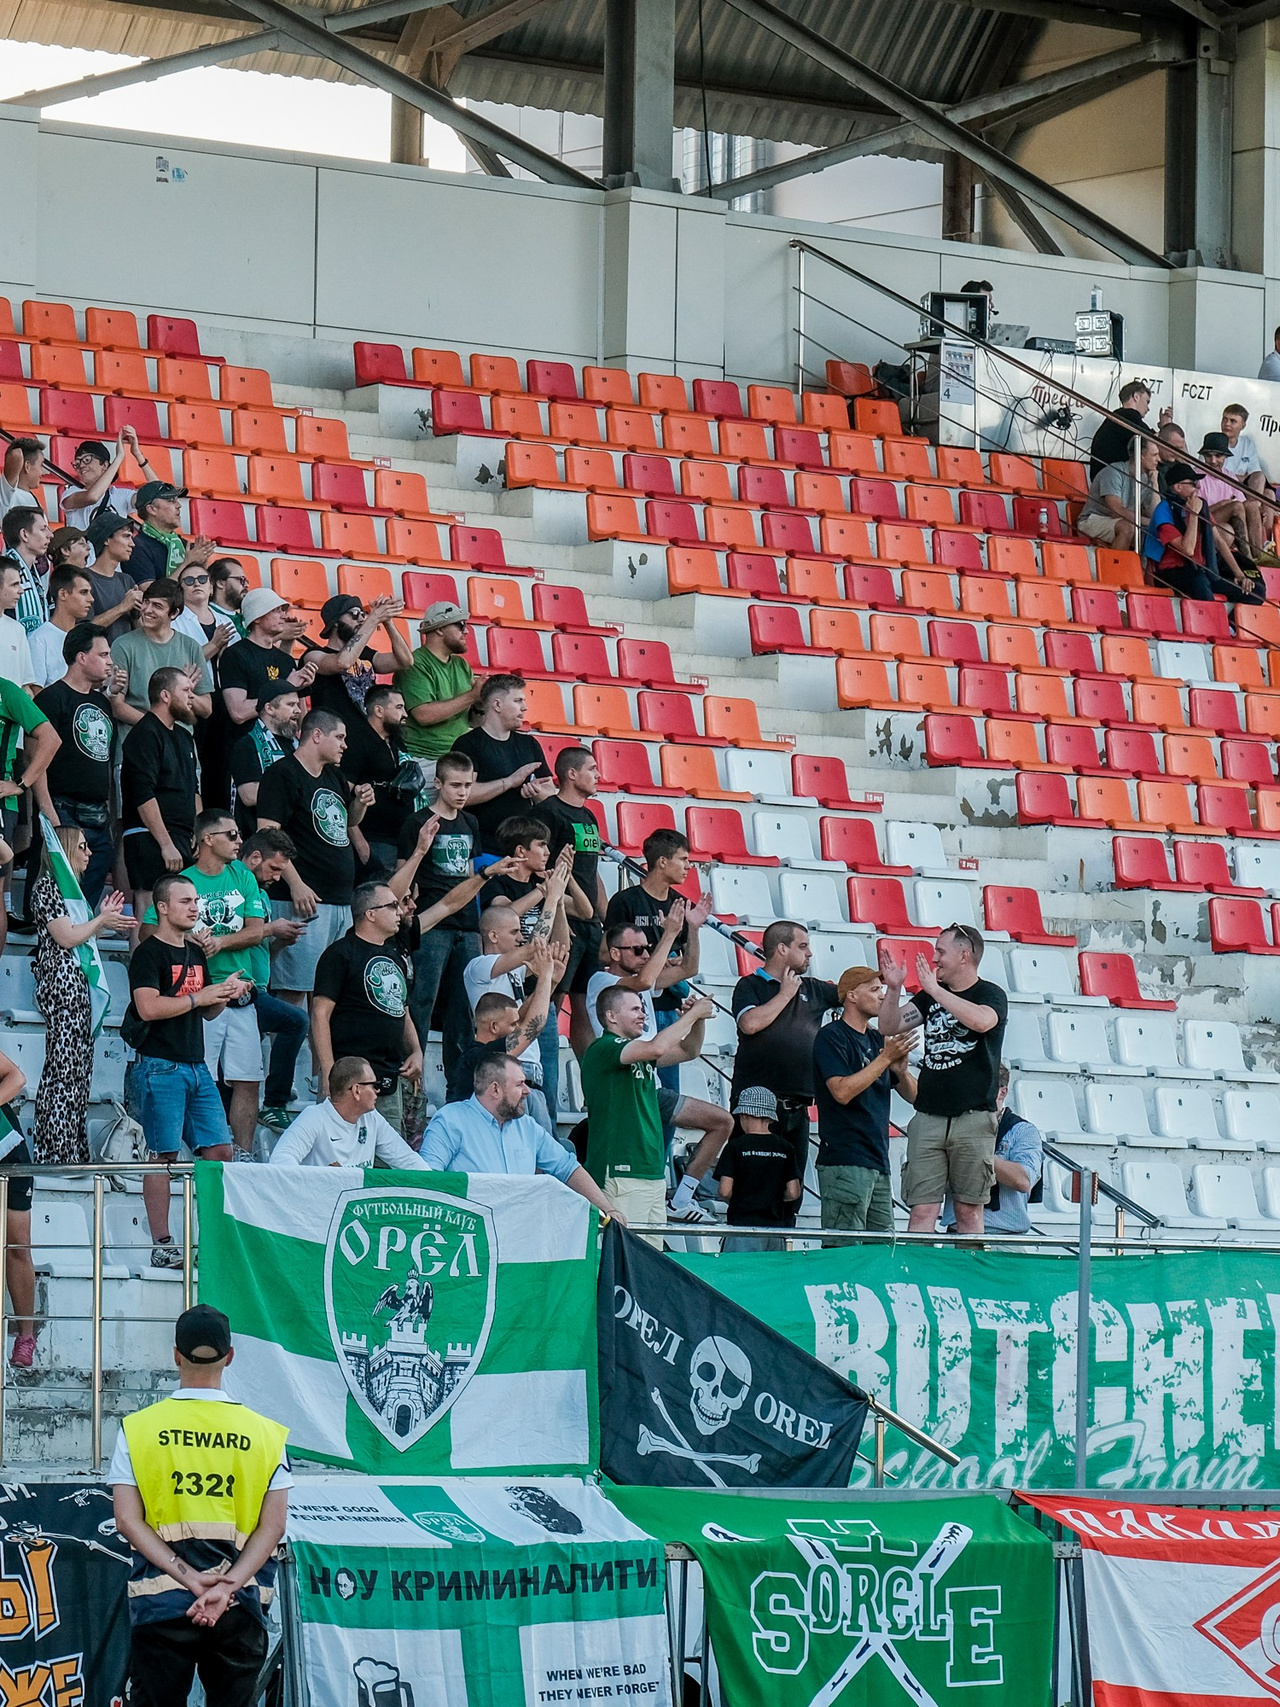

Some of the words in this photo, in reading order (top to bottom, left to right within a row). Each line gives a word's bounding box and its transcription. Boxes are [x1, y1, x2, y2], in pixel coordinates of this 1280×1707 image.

[943, 388, 951, 399] 4
[1181, 383, 1214, 401] FCZT
[45, 1215, 49, 1223] 5
[352, 1201, 443, 1221] ФУТБОЛЬНЫЙ
[444, 1210, 477, 1231] КЛУБ
[339, 1219, 483, 1278] ОРЁЛ
[804, 1281, 1280, 1461] BUTCHE
[753, 1391, 834, 1450] OREL
[158, 1429, 252, 1451] STEWARD
[342, 1505, 380, 1513] GOOD
[308, 1564, 378, 1601] НОУ
[391, 1557, 658, 1601] КРИМИНАЛИТИ
[546, 1668, 583, 1682] WHEN
[585, 1666, 621, 1680] WE'RE
[623, 1663, 647, 1677] BAD
[538, 1688, 573, 1702] THEY
[576, 1686, 613, 1701] NEVER
